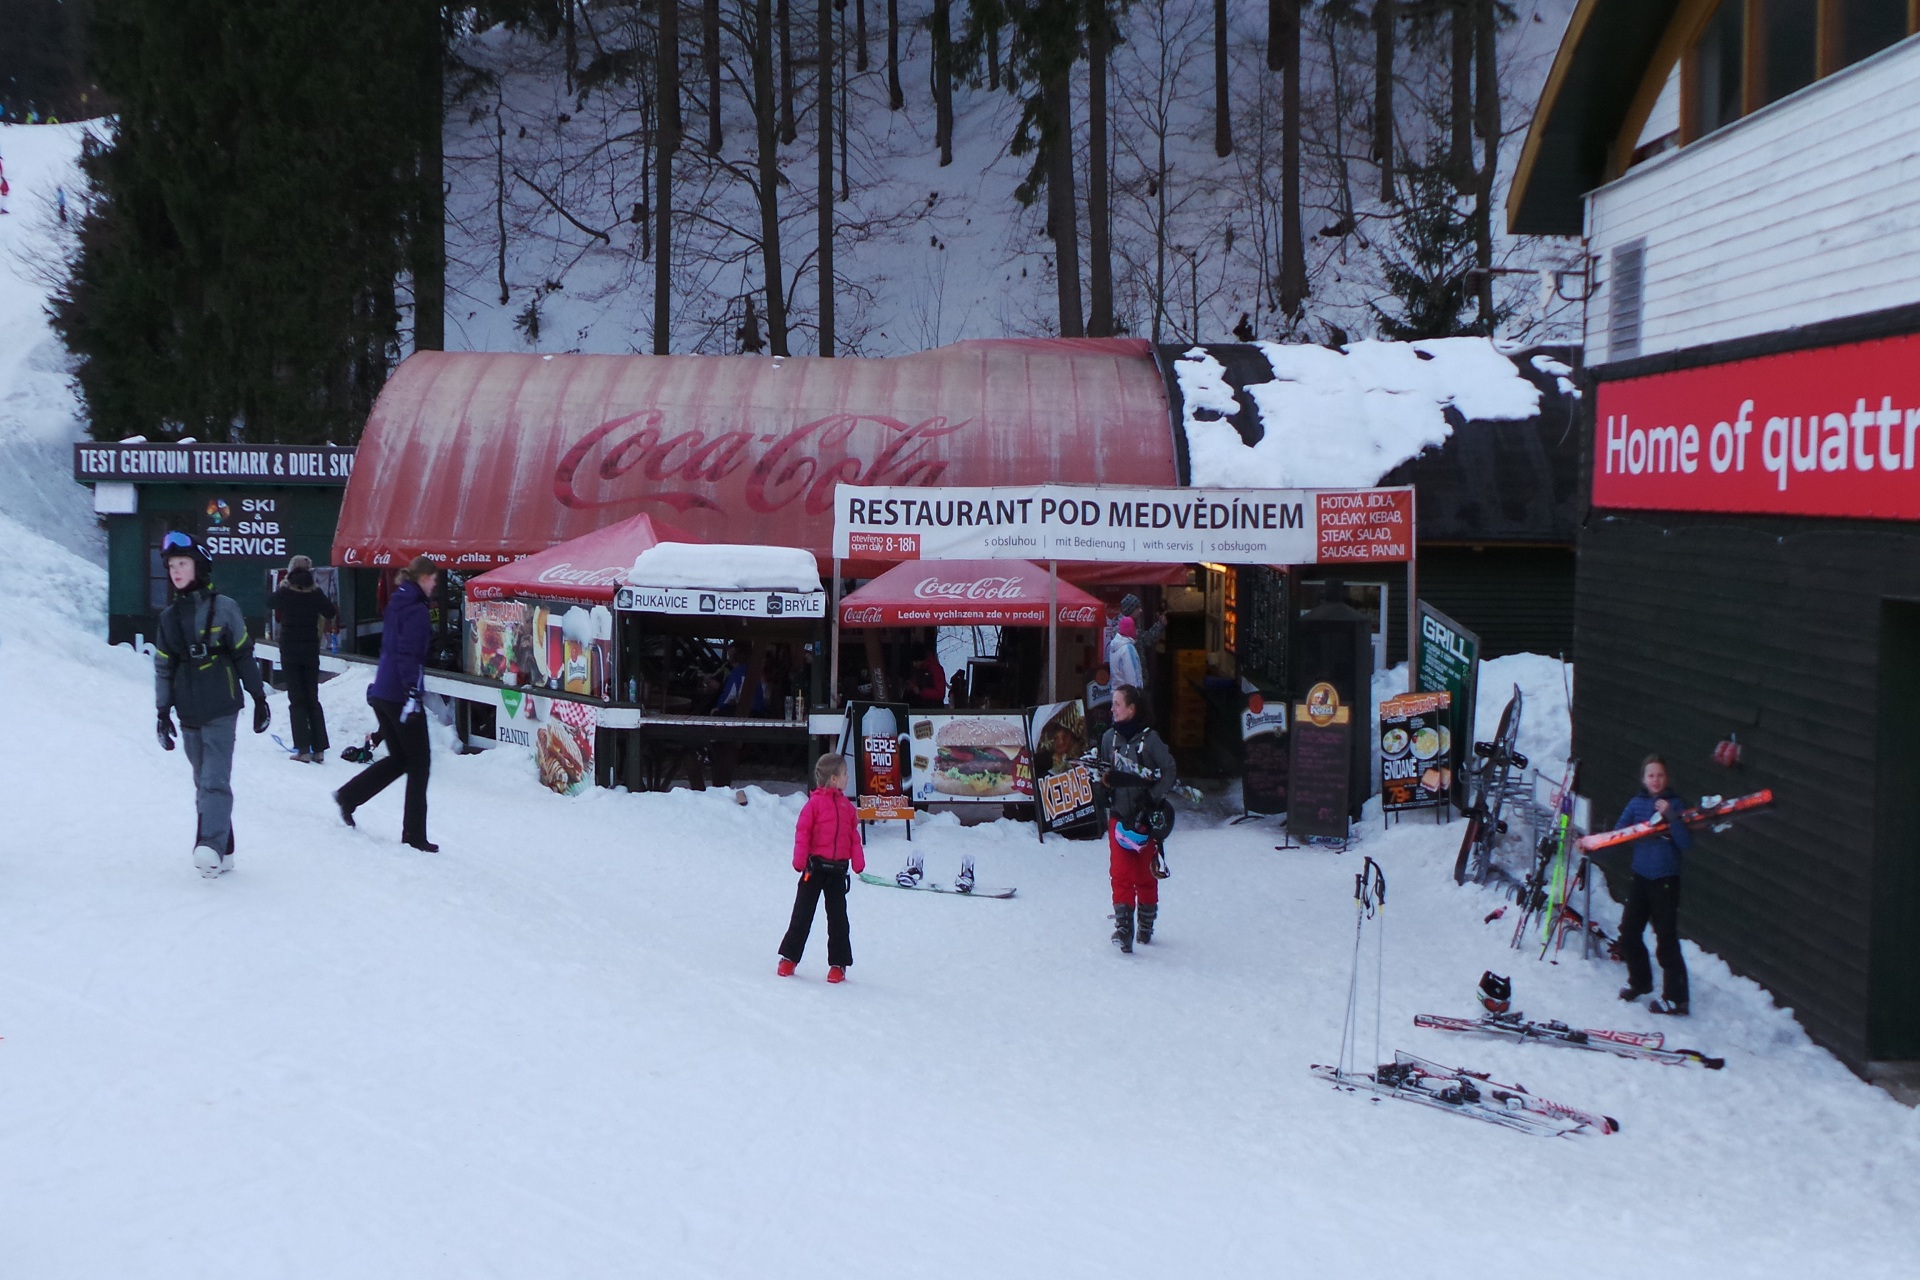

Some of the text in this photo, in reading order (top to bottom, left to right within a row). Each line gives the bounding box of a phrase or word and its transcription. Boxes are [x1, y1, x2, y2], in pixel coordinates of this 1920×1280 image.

[1606, 414, 1699, 474] Home
[1709, 399, 1754, 473] of
[80, 450, 116, 473] TEST
[121, 450, 189, 474] CENTRUM
[193, 451, 269, 475] TELEMARK
[273, 453, 284, 475] &
[289, 453, 326, 476] DUEL
[242, 499, 276, 512] SKI
[1321, 494, 1364, 509] HOTOVÁ
[849, 498, 1304, 529] RESTAURANT POD MEDVĚDÍNEM
[1321, 511, 1403, 526] POLÉVKY, KEBAB,
[238, 521, 280, 534] SNB
[1322, 528, 1391, 542] STEAK, SALAD,
[206, 537, 287, 555] SERVICE
[851, 543, 868, 552] open
[984, 535, 1037, 547] s obsluhou
[1055, 536, 1126, 551] mit Bedienung
[1142, 538, 1194, 551] with servis
[1210, 542, 1215, 551] s
[1322, 544, 1405, 558] SAUSAGE, PANINI
[914, 576, 1023, 600] Coca-Cola
[635, 594, 688, 609] RUKAVICE
[718, 596, 756, 611] ČEPICE
[785, 597, 819, 612] BRÝLE
[844, 607, 883, 623] Coca-Cola
[986, 610, 1002, 619] zde
[1013, 611, 1045, 620] prodeji
[1058, 606, 1097, 622] Coca-Cola
[1422, 615, 1470, 664] GRILL
[1310, 704, 1334, 715] Kozel
[499, 726, 530, 747] PANINI
[870, 752, 892, 766] PIWO
[870, 775, 887, 793] 45
[1038, 765, 1093, 821] KEBAB
